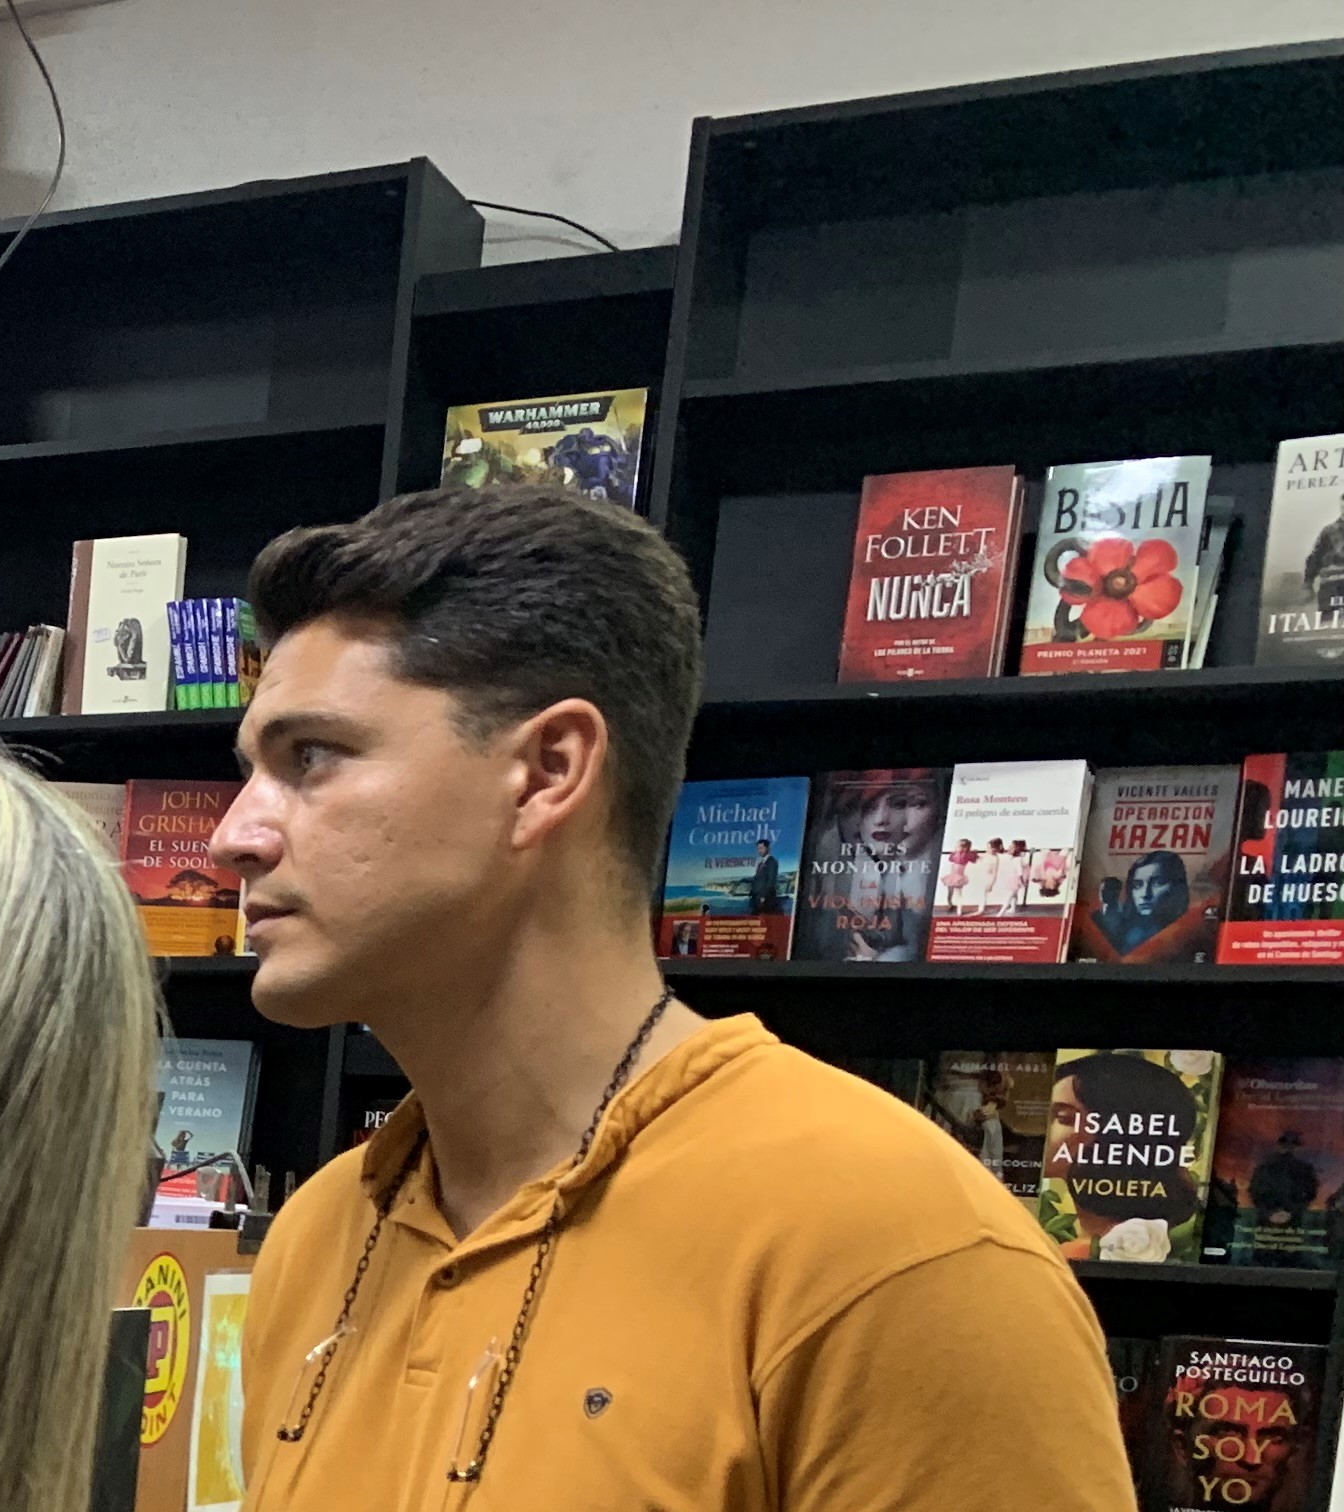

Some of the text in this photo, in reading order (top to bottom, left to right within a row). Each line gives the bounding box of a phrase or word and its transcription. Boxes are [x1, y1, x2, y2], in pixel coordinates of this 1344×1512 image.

[488, 401, 601, 425] WARHAMMER
[902, 504, 962, 531] KEN
[865, 527, 996, 563] FOLLETT
[867, 573, 972, 622] NUNCA
[1037, 647, 1147, 660] PREMIO PLANETA 2021
[162, 790, 220, 811] JOHN
[956, 794, 1029, 805] Rosa Montero
[1117, 785, 1168, 798] VICENTE
[695, 801, 778, 824] Michael
[954, 807, 1036, 820] El peligro de estar
[139, 815, 217, 834] GRISHA
[688, 823, 782, 846] Connelly
[150, 840, 163, 852] EL
[840, 842, 909, 857] REYES
[144, 856, 162, 868] DE
[811, 859, 933, 876] MONFORTE
[1240, 855, 1265, 875] LA
[859, 881, 879, 890] LA
[1247, 883, 1275, 904] DE
[808, 894, 928, 911] VIOLINISTA
[836, 915, 894, 932] ROJA
[177, 1060, 227, 1072] CUENTA
[950, 1061, 1012, 1073] ANNABEL
[170, 1073, 210, 1087] ATRÁS
[171, 1090, 205, 1102] PARA
[169, 1106, 223, 1119] VERANO
[1073, 1112, 1181, 1137] ISABEL
[983, 1159, 1003, 1169] DE
[1051, 1142, 1197, 1169] ALLENDE
[1071, 1178, 1169, 1199] VIOLETA
[1190, 1350, 1294, 1371] SANTIAGO
[1174, 1364, 1306, 1387] POSTEGUILLO
[1174, 1390, 1298, 1426] ROMA
[1192, 1433, 1273, 1465] SOY
[1197, 1474, 1253, 1505] YO
